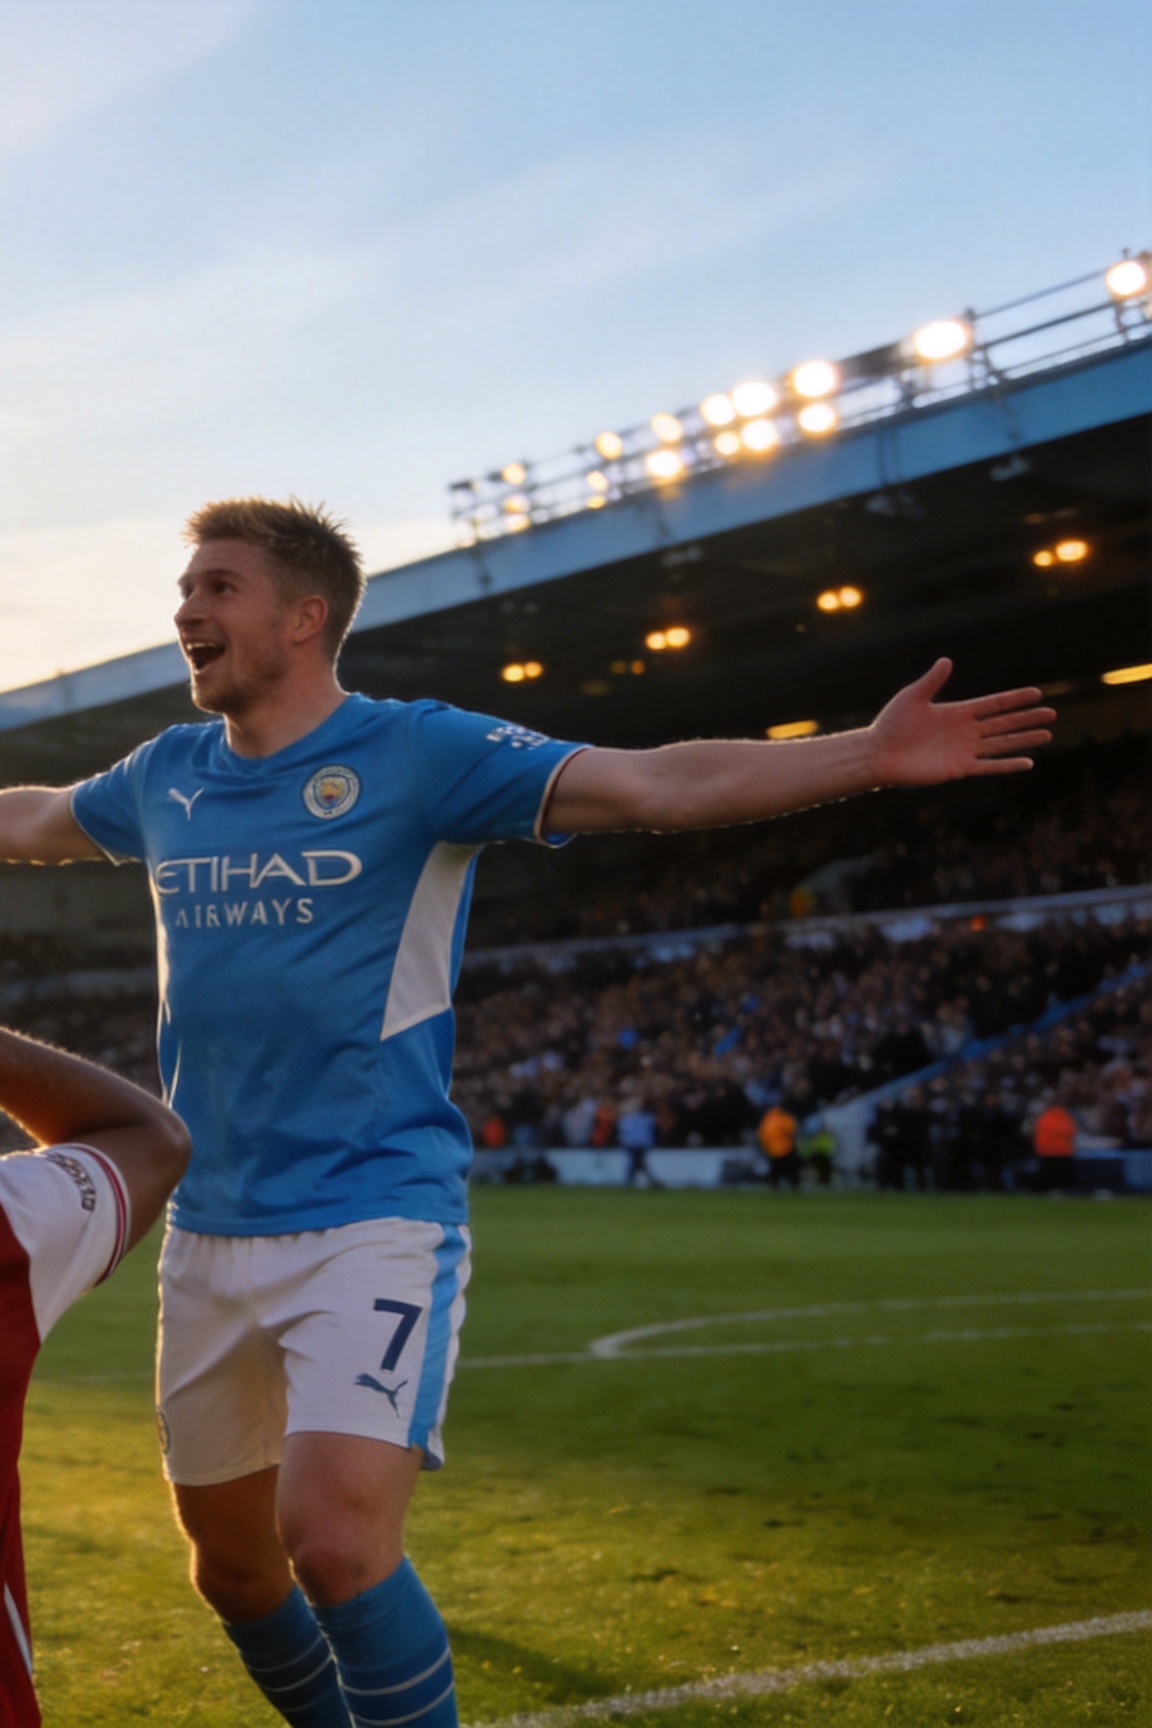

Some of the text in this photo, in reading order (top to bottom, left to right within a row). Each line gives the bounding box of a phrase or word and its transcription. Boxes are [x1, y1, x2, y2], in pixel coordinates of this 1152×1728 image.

[156, 850, 362, 894] ETIHAD
[175, 898, 314, 928] AIRWAYS
[373, 1298, 423, 1371] 7
